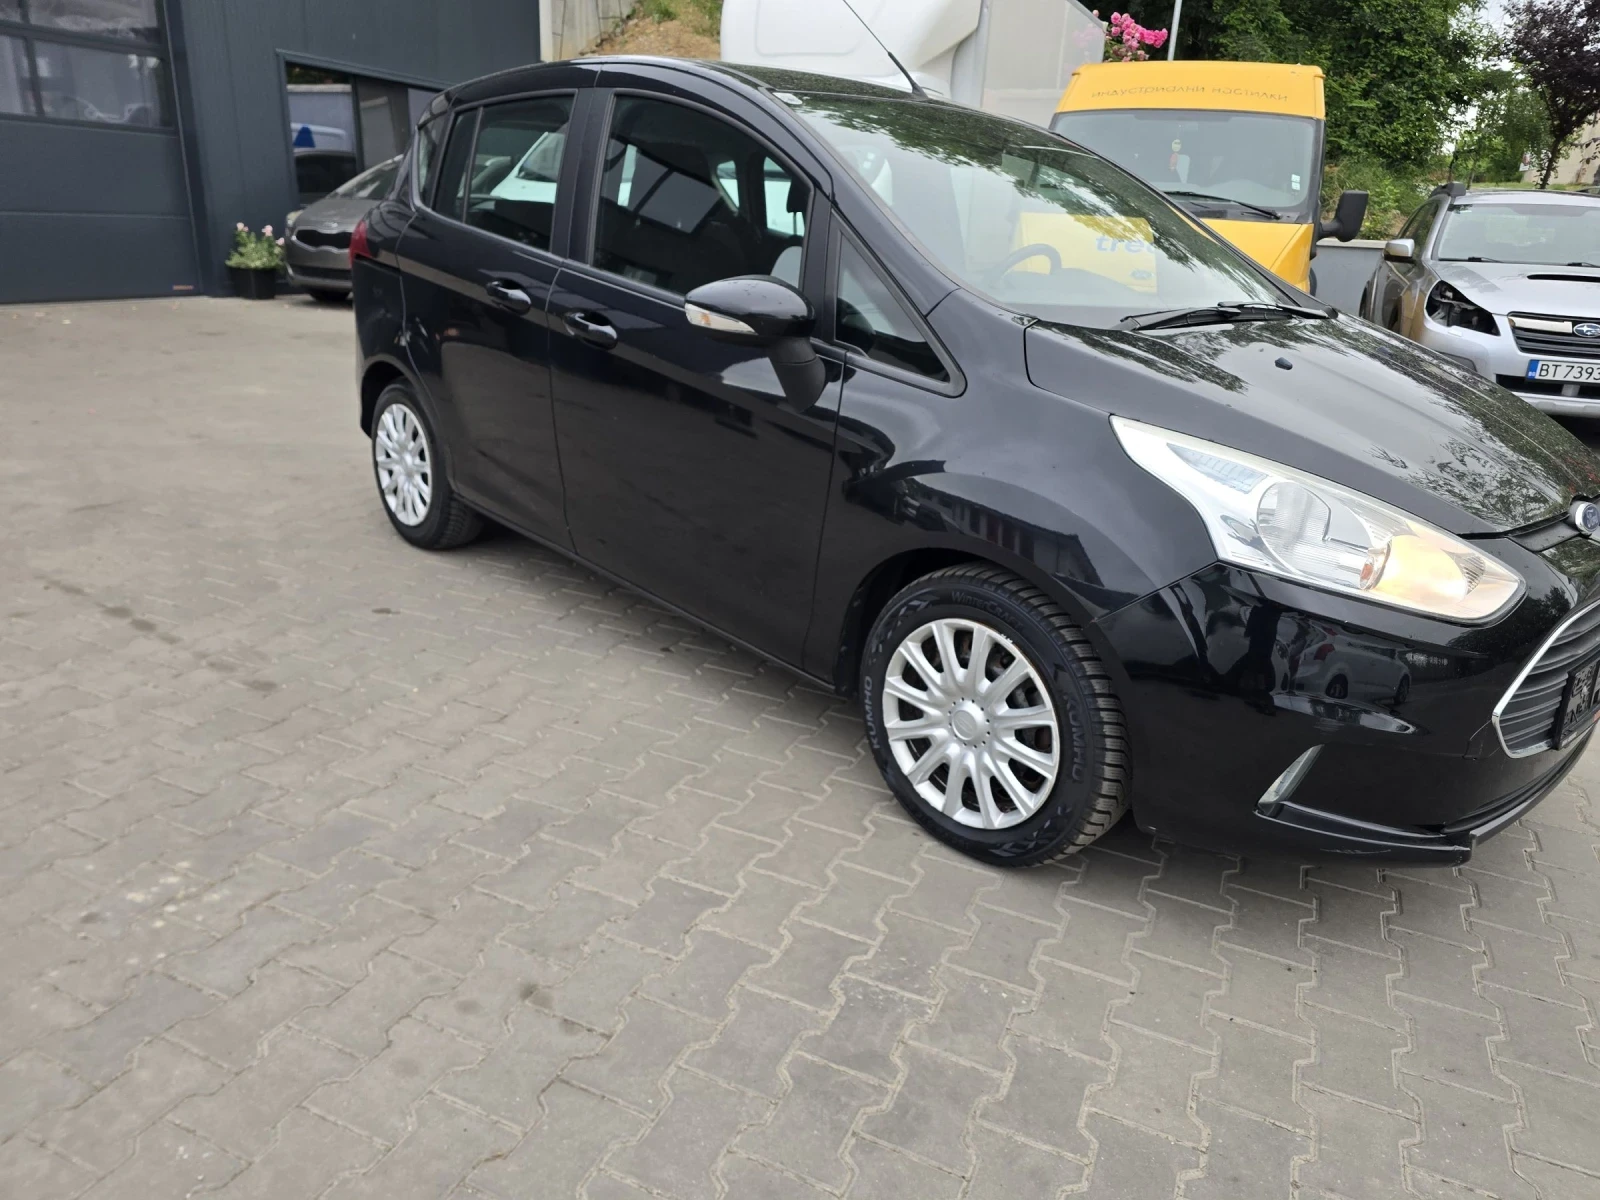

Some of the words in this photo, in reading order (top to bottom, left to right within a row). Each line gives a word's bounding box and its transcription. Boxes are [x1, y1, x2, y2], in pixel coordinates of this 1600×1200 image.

[1211, 86, 1288, 102] настилки
[1538, 363, 1562, 378] BT
[864, 675, 880, 749] KUMHO
[1063, 693, 1087, 784] KUMHO
